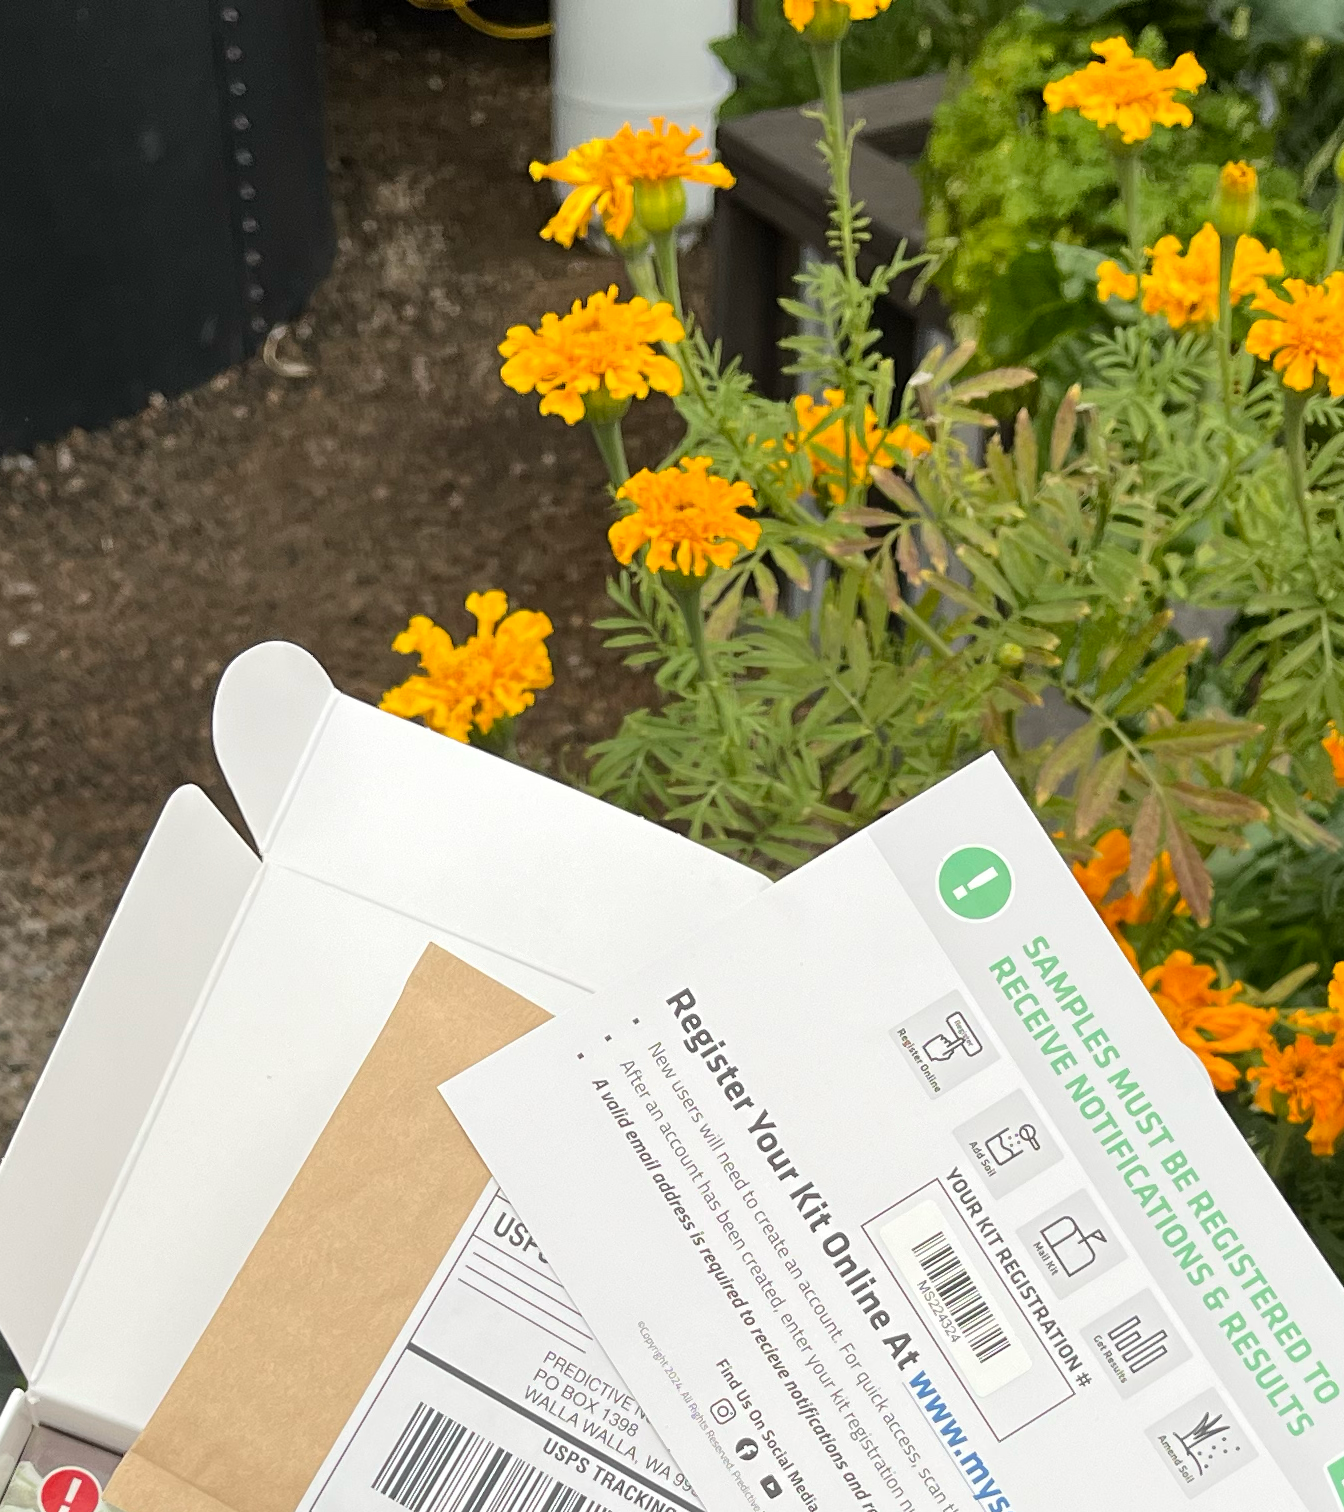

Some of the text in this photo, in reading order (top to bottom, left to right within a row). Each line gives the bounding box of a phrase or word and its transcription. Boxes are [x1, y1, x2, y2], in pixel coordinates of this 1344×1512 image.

[591, 1079, 610, 1091] A
[896, 1027, 941, 1093] Register Online
[600, 1091, 635, 1129] valid
[625, 1130, 662, 1171] email
[665, 986, 920, 1372] Register Your Kit Online At
[968, 1140, 997, 1178] Add Soil
[1022, 934, 1341, 1403] SAMPLES MUST BE REGISTERED TO
[651, 1172, 696, 1231] address
[988, 955, 1314, 1437] RECEIVE NOTIFICATIONS & RESULTS
[492, 1211, 549, 1265] USP
[688, 1230, 706, 1246] is
[1032, 1240, 1059, 1276] Mail Kit
[618, 1059, 651, 1098] After
[644, 1100, 664, 1122] an
[658, 1121, 704, 1184] account
[696, 1179, 722, 1212] has
[715, 1208, 746, 1251] been
[741, 1251, 787, 1313] created,
[779, 1312, 813, 1353] enter
[803, 1353, 836, 1388] your
[829, 1387, 851, 1413] kit
[843, 1411, 904, 1499] registration
[647, 1040, 677, 1079] New
[671, 1079, 704, 1123] users
[698, 1122, 726, 1152] will
[715, 1151, 751, 1191] need
[741, 1189, 758, 1209] to
[753, 1209, 789, 1259] create
[783, 1257, 803, 1280] an
[797, 1280, 844, 1344] account.
[838, 1341, 863, 1369] For
[855, 1371, 889, 1413] quick
[882, 1412, 921, 1468] access,
[917, 1467, 947, 1505] scan
[698, 1247, 750, 1309] required
[945, 1165, 1092, 1387] YOUR KIT REGISTRATION #
[739, 1309, 756, 1326] to
[916, 1278, 961, 1343] MS224324
[749, 1327, 790, 1379] recieve
[1092, 1334, 1128, 1384] Get Results
[531, 1367, 639, 1437] PO BOX 1398
[542, 1349, 653, 1427] PREDICTIVE N
[715, 1357, 743, 1391] Find
[735, 1388, 753, 1410] Us
[748, 1408, 765, 1431] On
[761, 1429, 795, 1472] Social
[524, 1384, 699, 1498] WALLA WALLA, WA 99
[542, 1436, 590, 1474] USPS
[663, 1365, 683, 1393] 2024.
[687, 1401, 709, 1432] Rights
[704, 1428, 736, 1473] Reserved.
[730, 1469, 761, 1512] Predictive
[783, 1380, 849, 1470] notifications
[842, 1471, 872, 1501] and
[1156, 1434, 1195, 1484] Amend Soil
